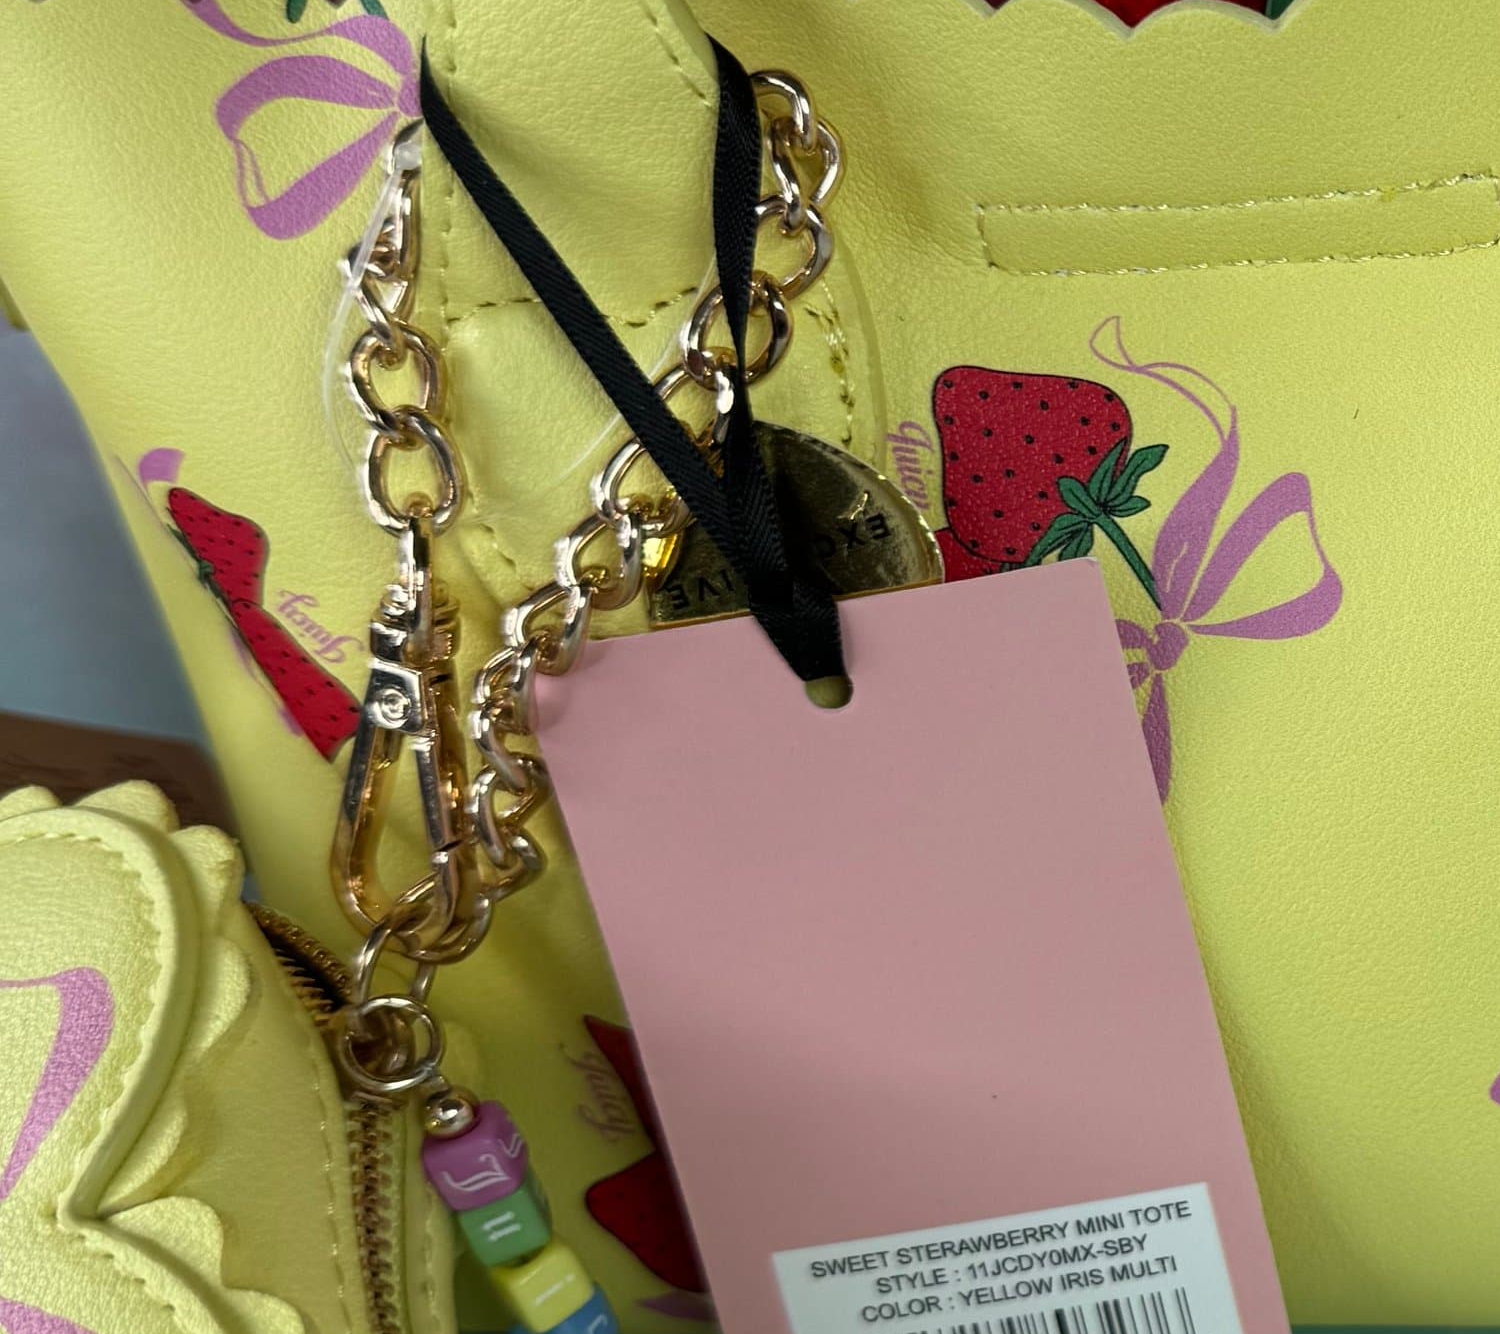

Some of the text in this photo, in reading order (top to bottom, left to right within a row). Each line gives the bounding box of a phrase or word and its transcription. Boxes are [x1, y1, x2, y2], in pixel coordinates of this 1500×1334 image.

[811, 1200, 1193, 1277] SWEET STERAWBERRY MINI TOTE
[876, 1268, 949, 1294] STYLE
[967, 1234, 1148, 1280] 11JCDY0MX-SBY
[861, 1295, 943, 1322] COLOR
[959, 1276, 1054, 1307] YELLOW
[1060, 1268, 1105, 1292] IRIS
[1110, 1255, 1178, 1282] MULTI
